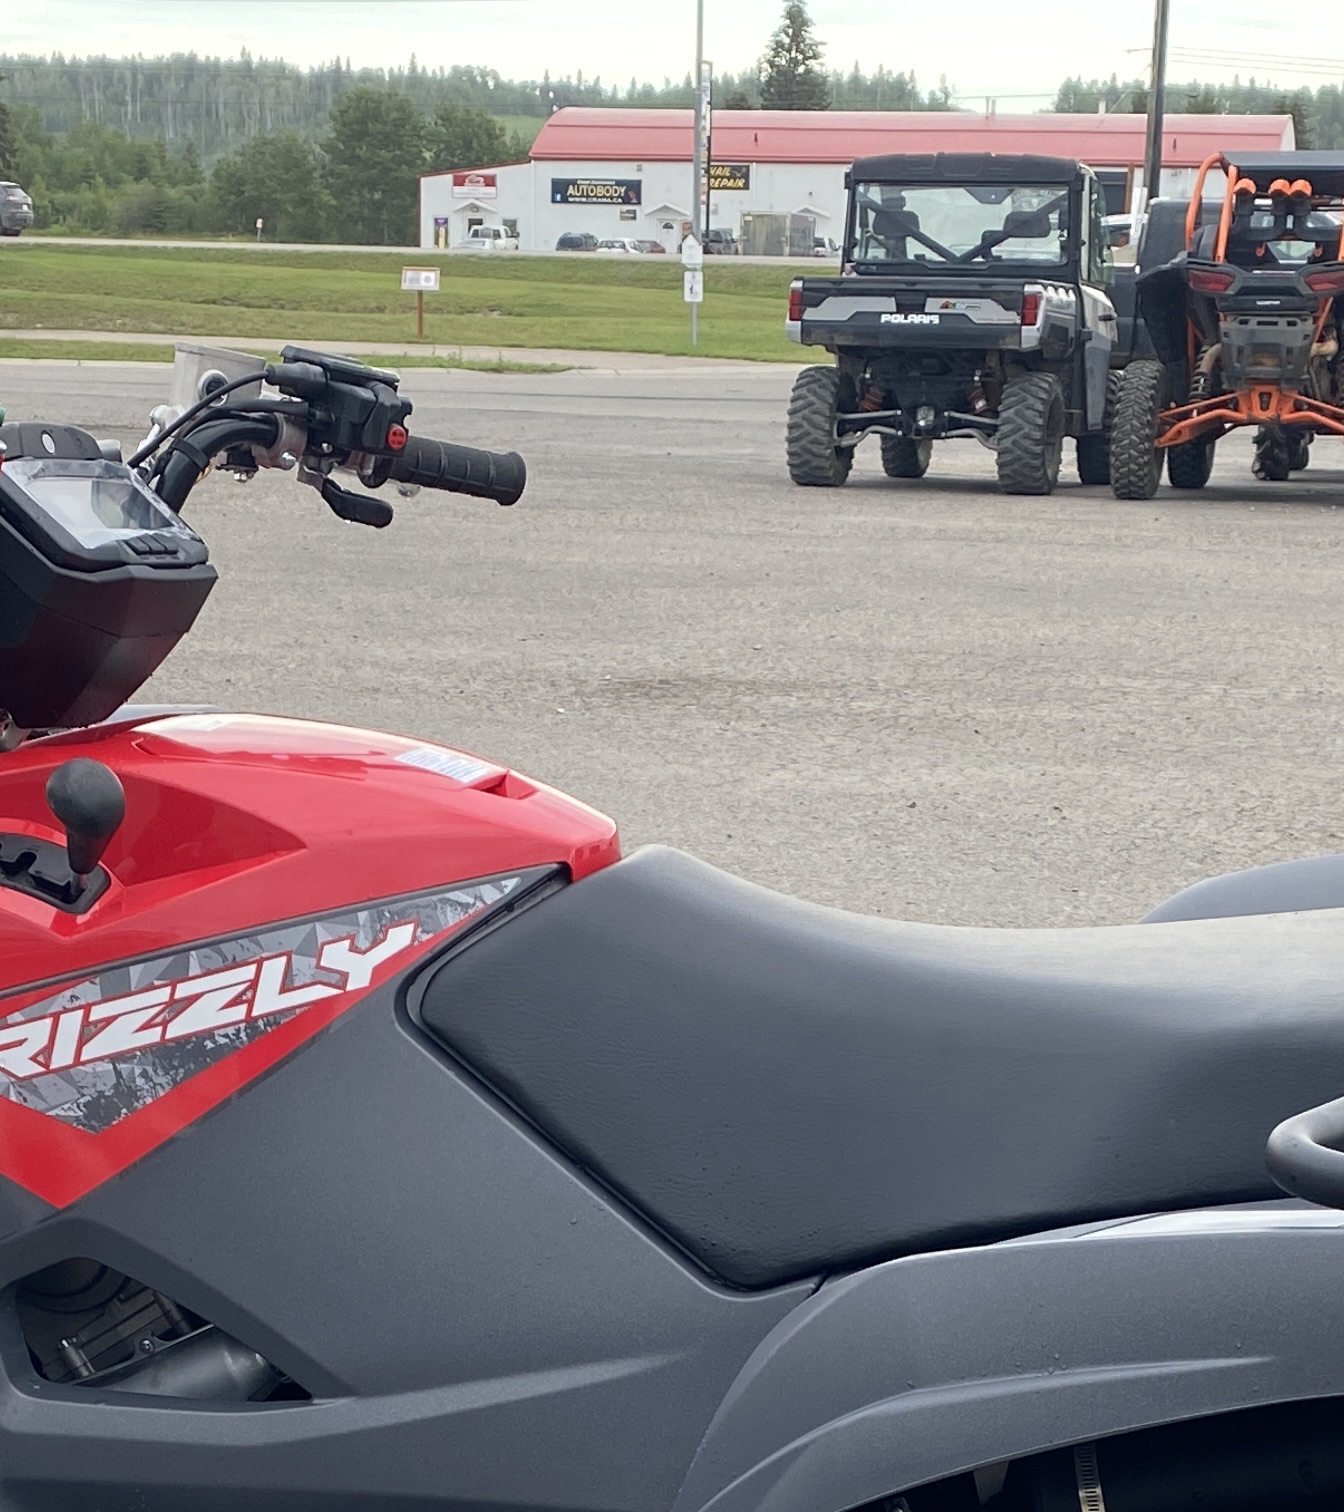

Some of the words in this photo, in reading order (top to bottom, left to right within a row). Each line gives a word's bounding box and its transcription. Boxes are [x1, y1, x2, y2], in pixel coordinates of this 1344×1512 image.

[710, 178, 746, 188] REPAIR
[567, 184, 627, 197] AUTOBODY
[880, 313, 940, 324] POLARIS
